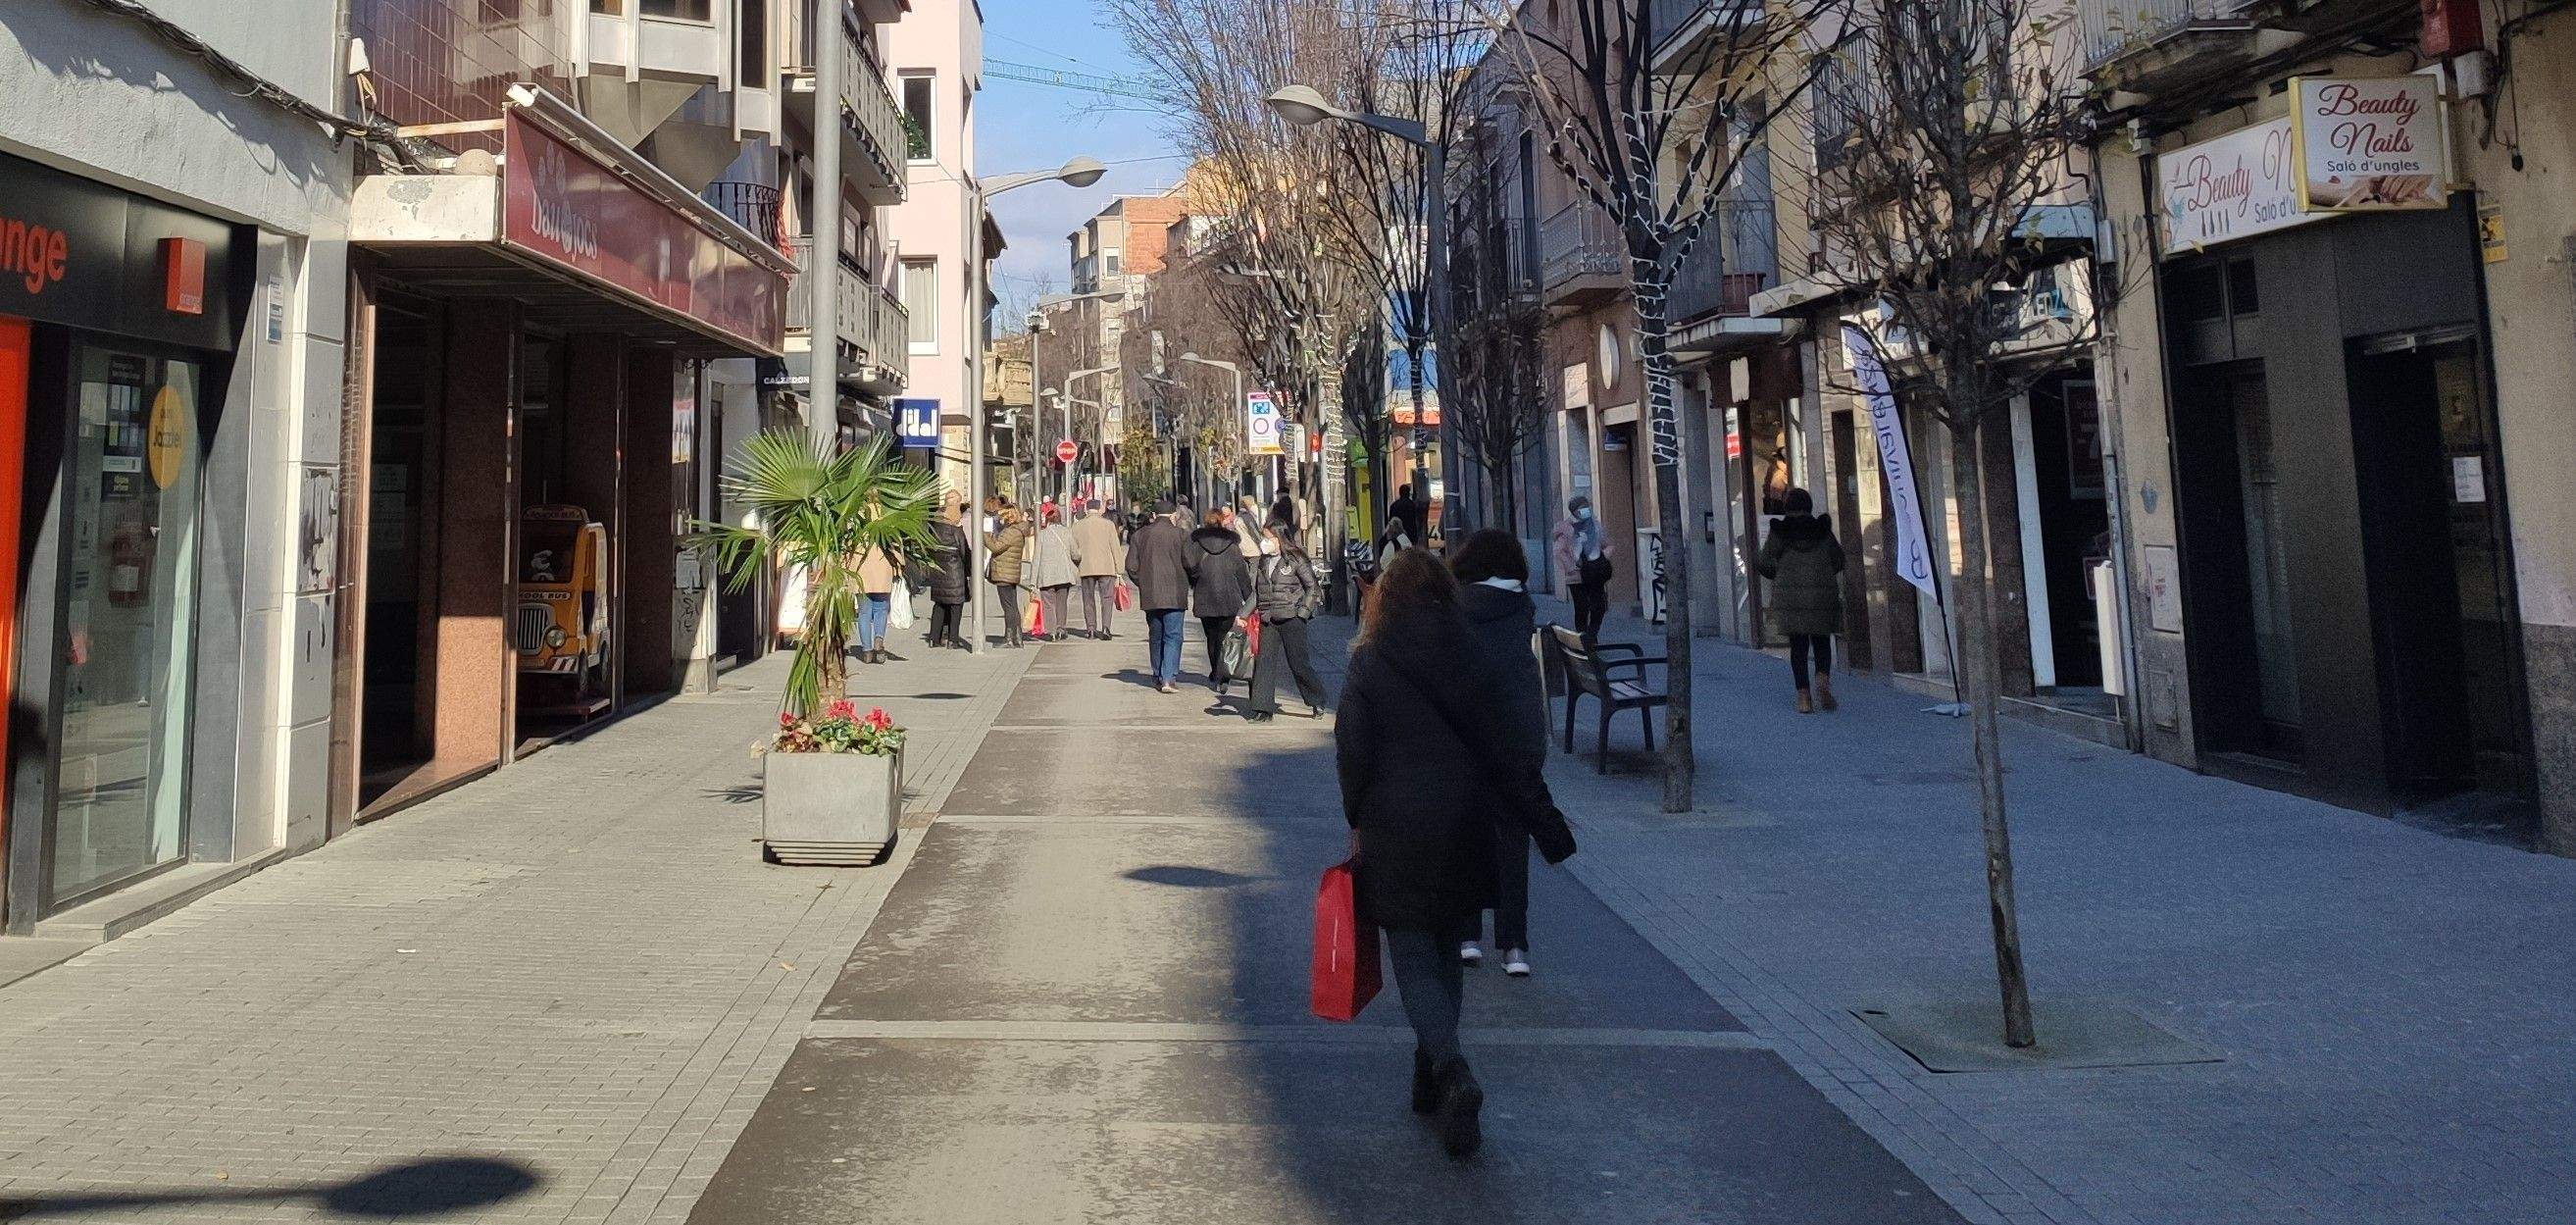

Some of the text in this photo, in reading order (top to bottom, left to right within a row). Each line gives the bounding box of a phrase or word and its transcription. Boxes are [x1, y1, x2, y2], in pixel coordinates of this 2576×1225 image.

[2317, 83, 2421, 126] Beauty
[2330, 122, 2414, 159] Nails
[2187, 153, 2253, 218] Beauty
[2327, 159, 2420, 174] Saló d'ungles
[0, 218, 69, 295] nge
[764, 376, 810, 385] CALZEDON
